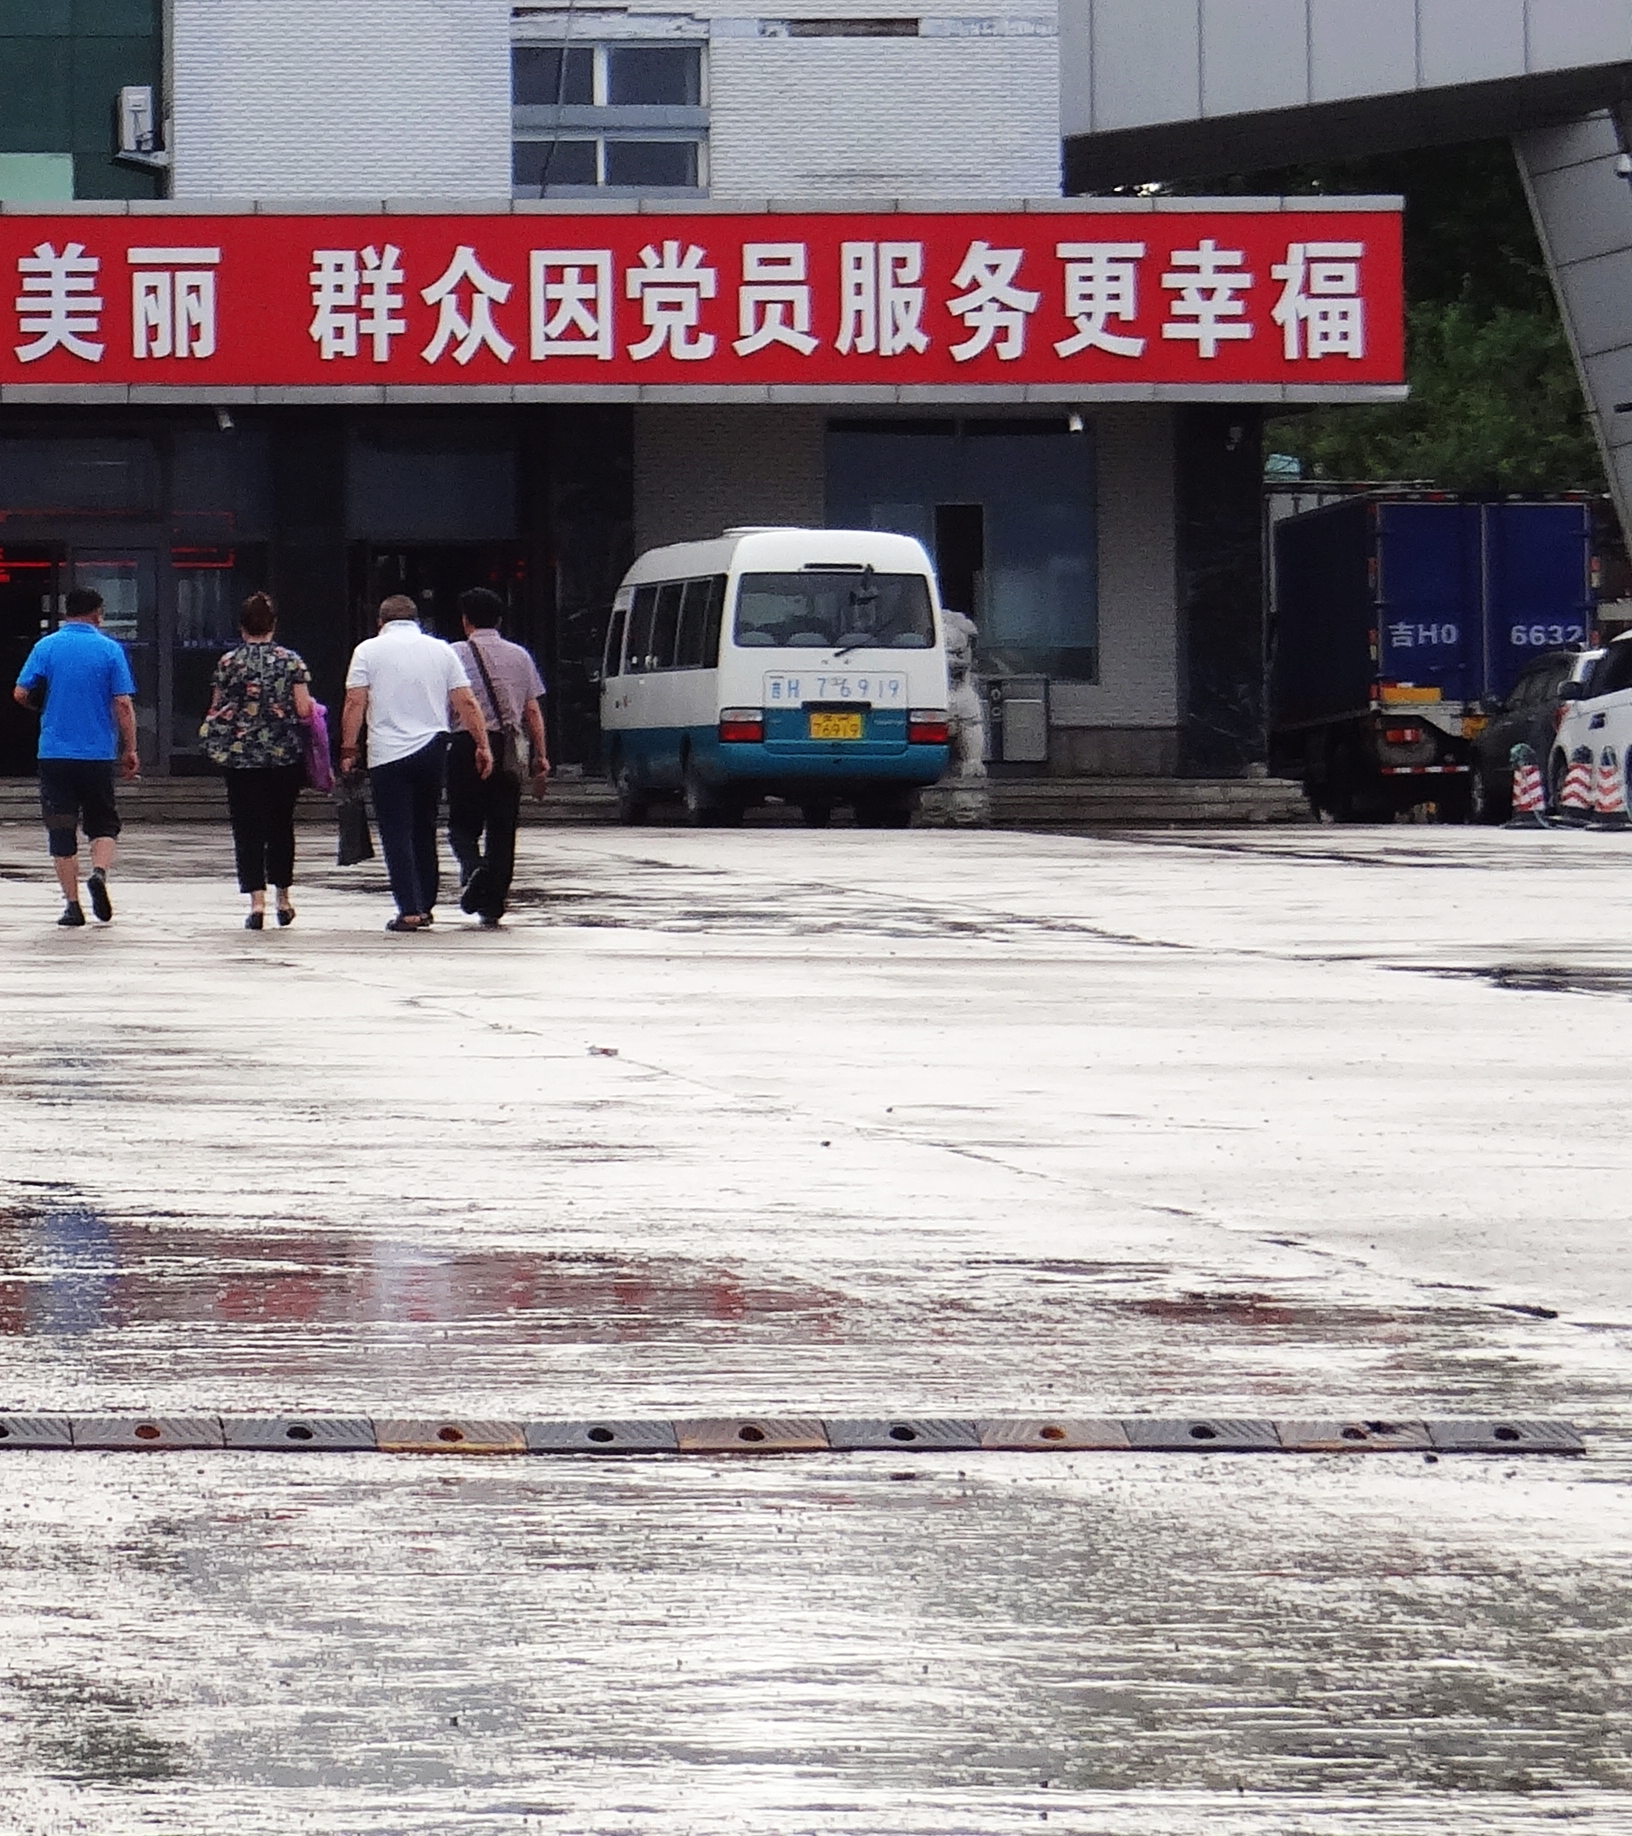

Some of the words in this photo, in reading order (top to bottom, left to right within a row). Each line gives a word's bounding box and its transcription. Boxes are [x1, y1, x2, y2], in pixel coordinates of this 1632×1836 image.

[309, 240, 1363, 364] 群众因党员服务更幸福
[1388, 622, 1459, 647] 吉H0
